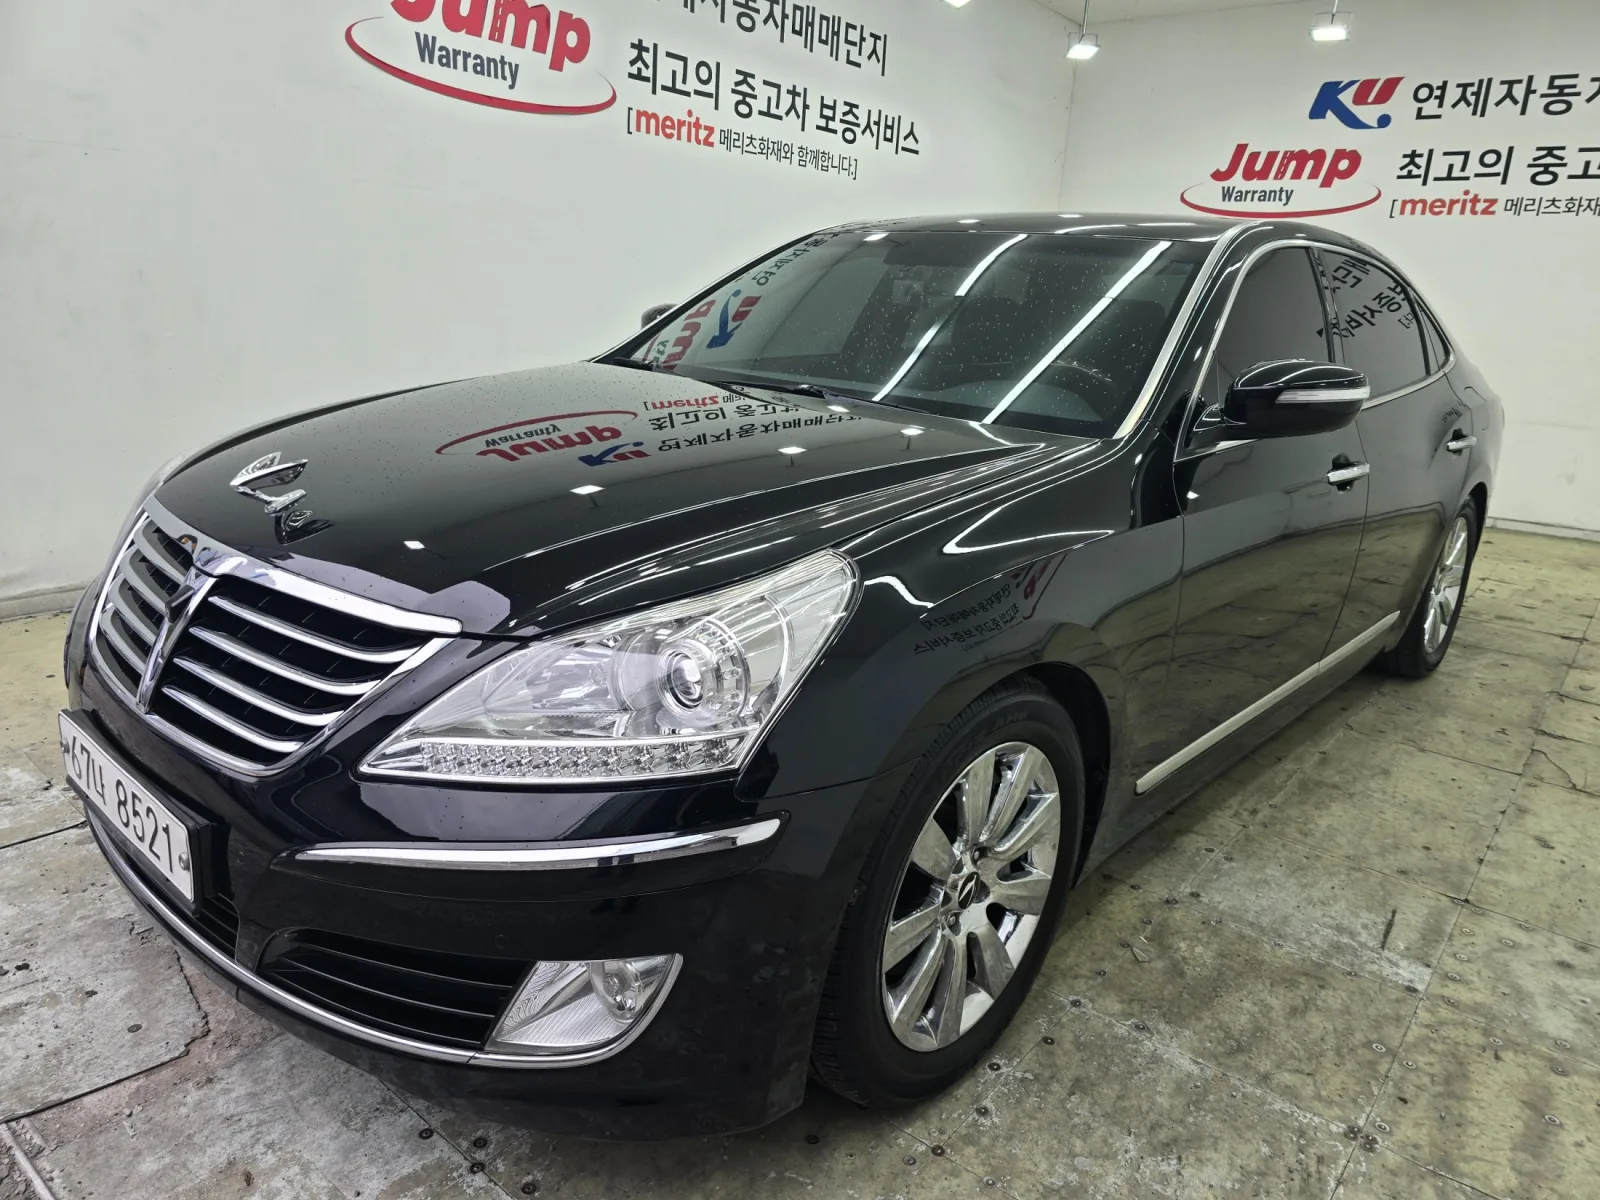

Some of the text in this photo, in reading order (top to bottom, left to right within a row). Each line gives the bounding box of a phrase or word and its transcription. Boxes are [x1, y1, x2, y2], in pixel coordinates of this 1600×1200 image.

[415, 31, 520, 90] Warranty
[627, 38, 920, 155] 최고의 중고차 보증서비스
[720, 129, 795, 165] 메리츠화재와
[797, 145, 858, 181] 함께합니다.]
[1210, 143, 1362, 188] Jump
[1396, 146, 1515, 187] 최고의
[1221, 186, 1294, 206] Warranty
[116, 779, 174, 874] 8521
